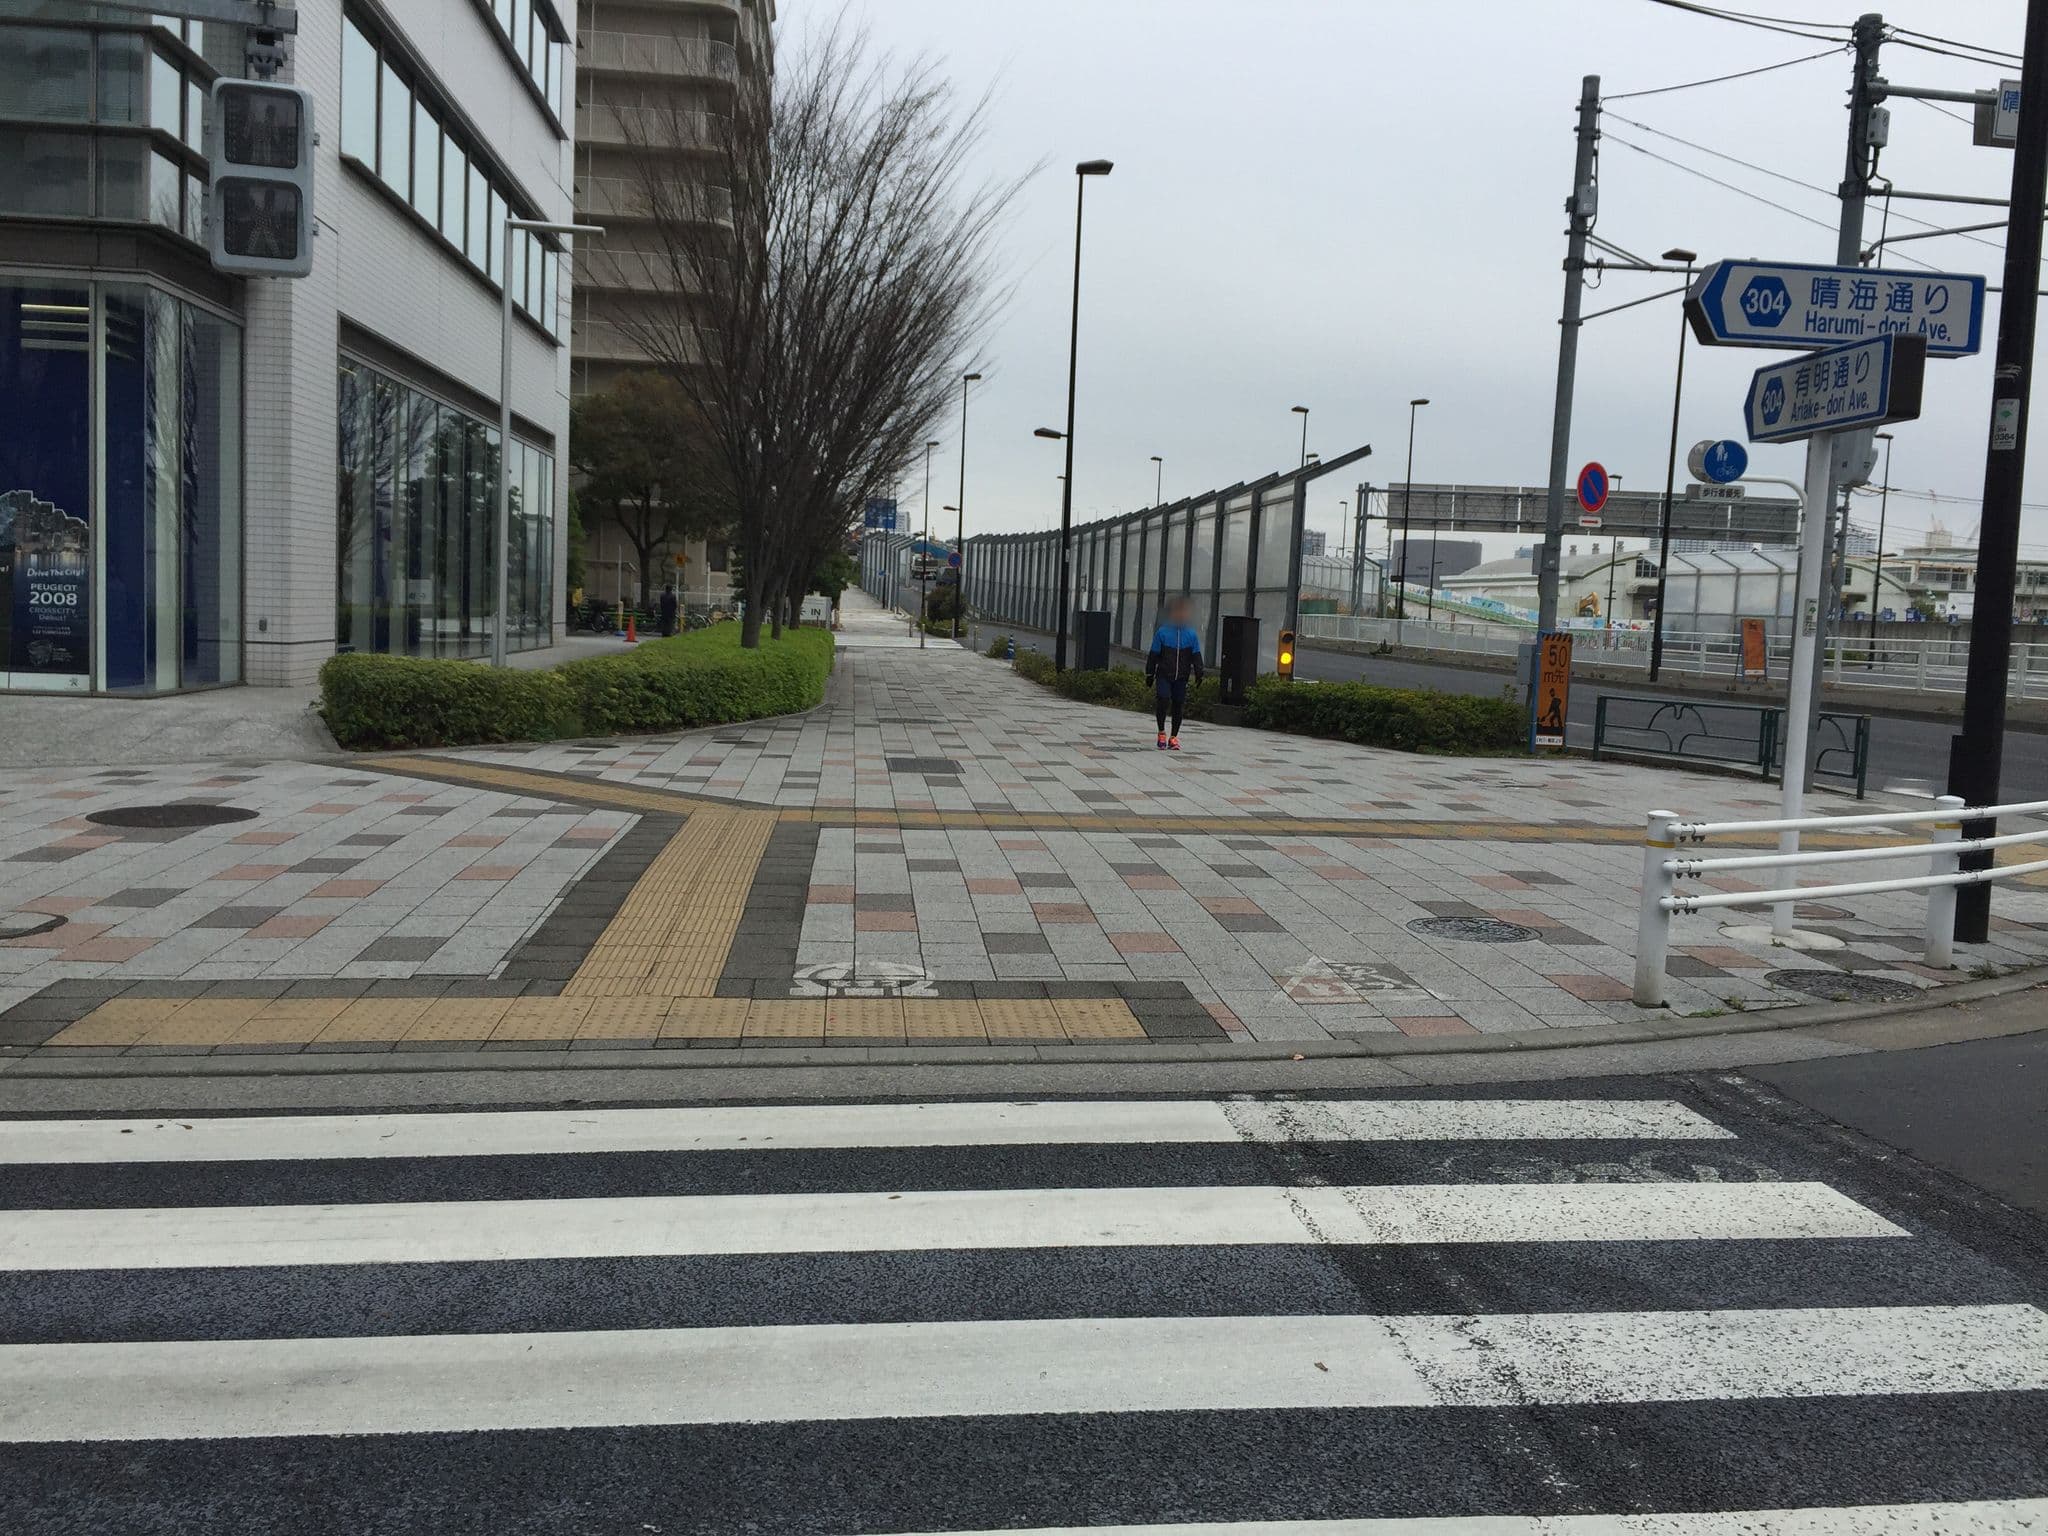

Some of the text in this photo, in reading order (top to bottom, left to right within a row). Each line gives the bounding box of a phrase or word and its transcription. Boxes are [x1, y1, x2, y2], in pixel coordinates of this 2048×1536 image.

[1745, 288, 1786, 315] 304
[1810, 276, 1950, 315] 晴海通り
[1918, 317, 1952, 342] Ave.
[1794, 351, 1871, 399] 有明通り
[1763, 389, 1783, 414] 304
[1790, 390, 1870, 423] Ariake-dori Ave.
[27, 568, 49, 577] Drive
[50, 569, 64, 577] The
[29, 591, 77, 606] 2008
[30, 583, 77, 591] PEUGEOT
[811, 608, 821, 616] IN
[1548, 645, 1568, 668] 50
[1543, 670, 1565, 684] m先
